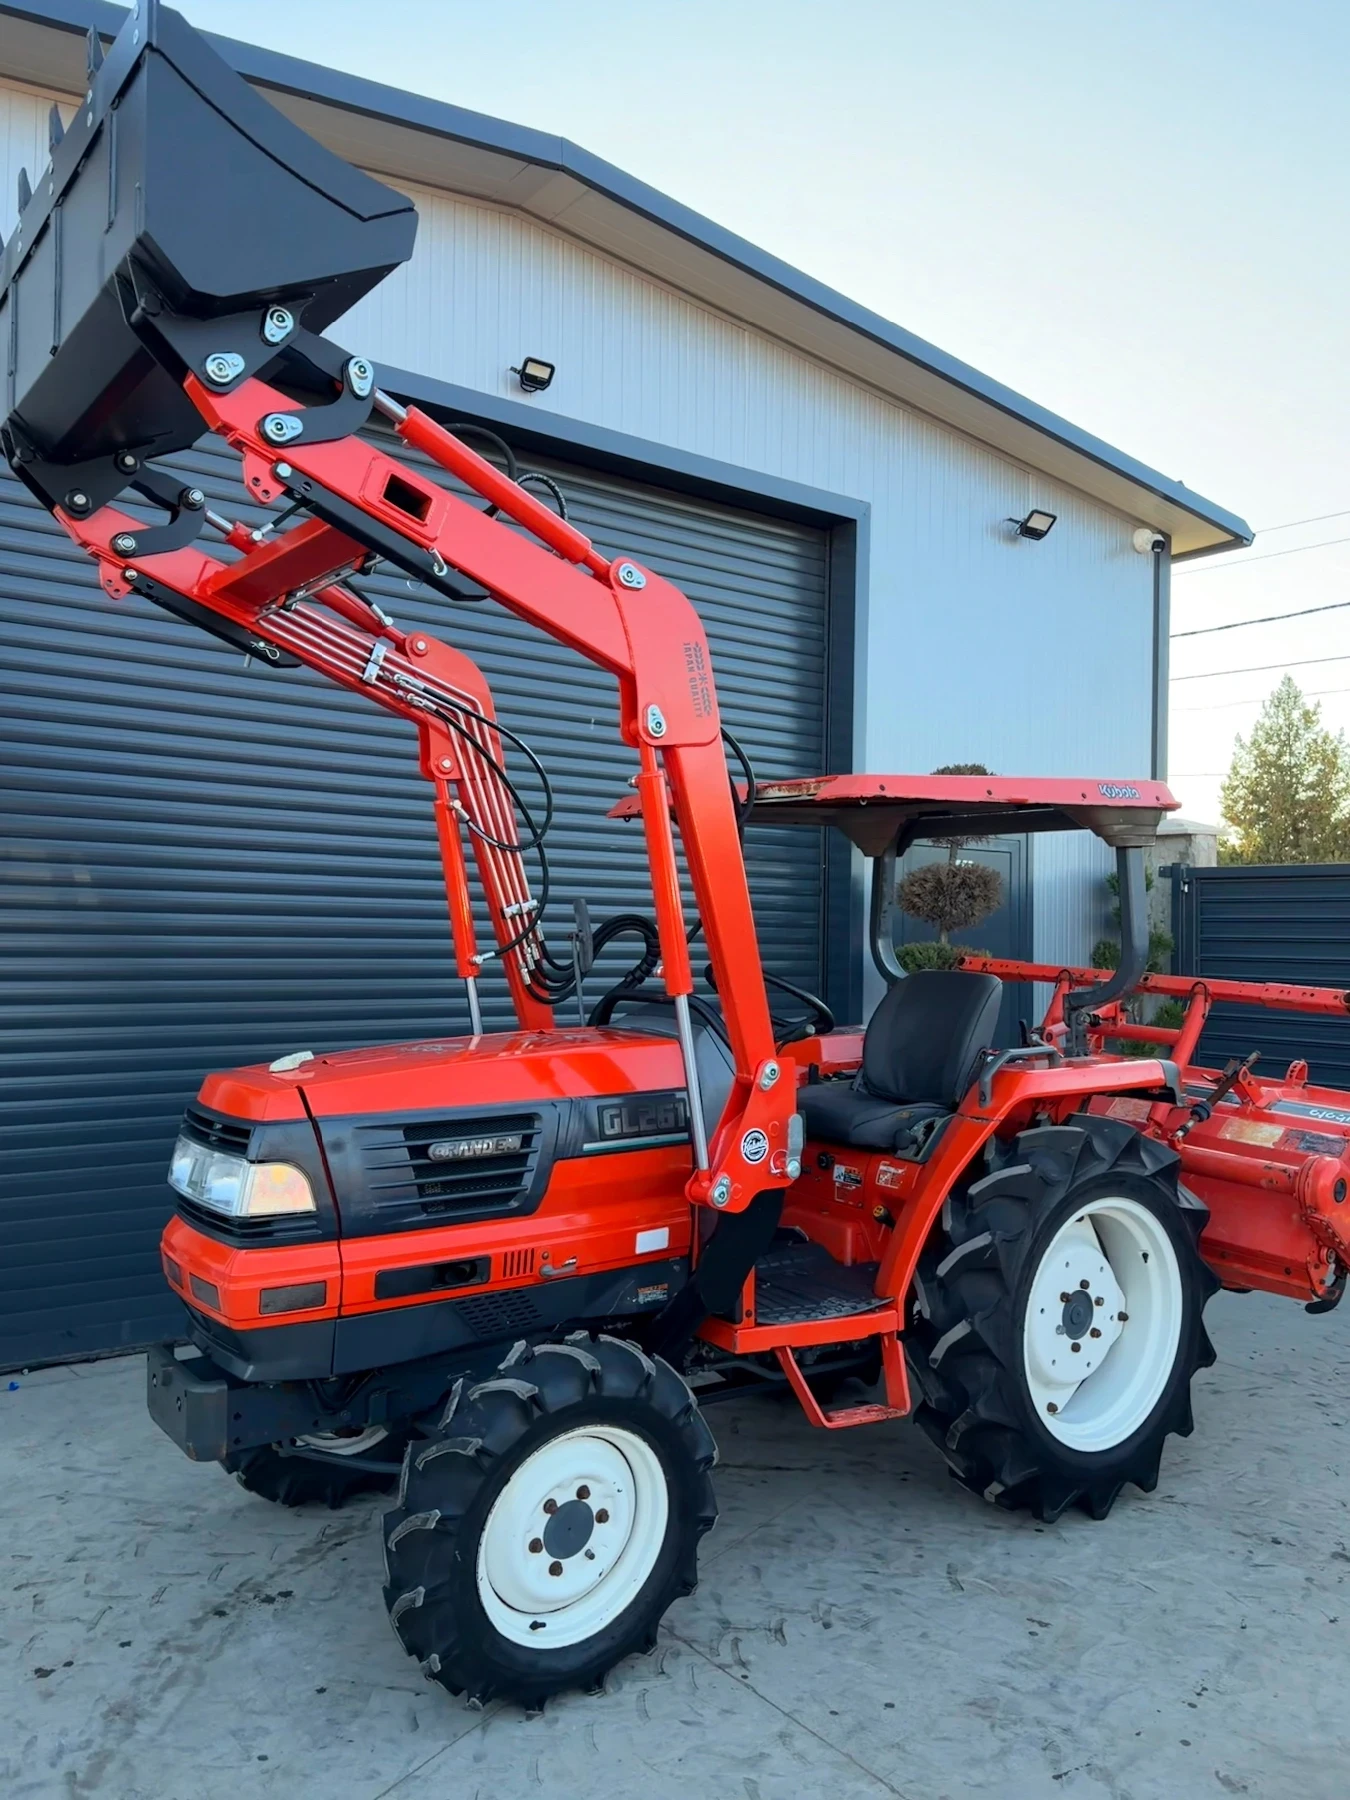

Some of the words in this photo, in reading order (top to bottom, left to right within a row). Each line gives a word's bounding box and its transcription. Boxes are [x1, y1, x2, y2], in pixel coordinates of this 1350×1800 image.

[683, 642, 695, 672] JAPAN
[689, 677, 703, 718] QUALITY
[1098, 783, 1140, 799] Kubota
[602, 1101, 686, 1136] GL261
